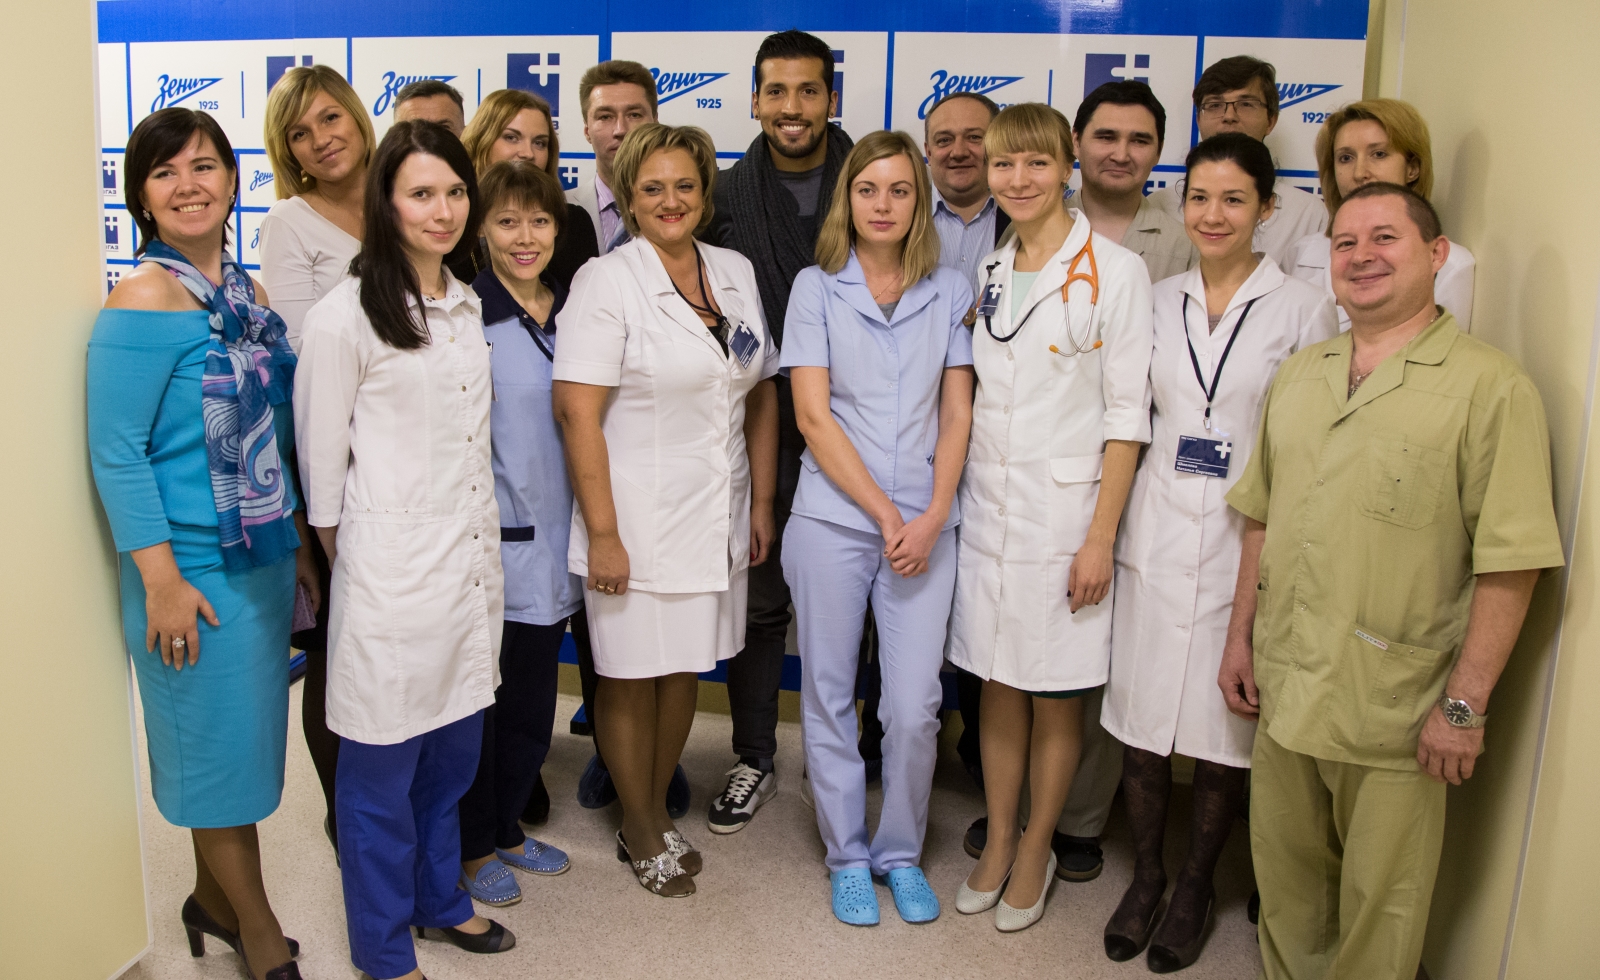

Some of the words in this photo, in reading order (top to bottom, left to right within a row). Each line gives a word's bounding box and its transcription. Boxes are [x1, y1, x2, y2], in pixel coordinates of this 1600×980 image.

[151, 74, 224, 114] Зенит
[199, 101, 219, 110] 1925
[696, 98, 722, 109] 1925
